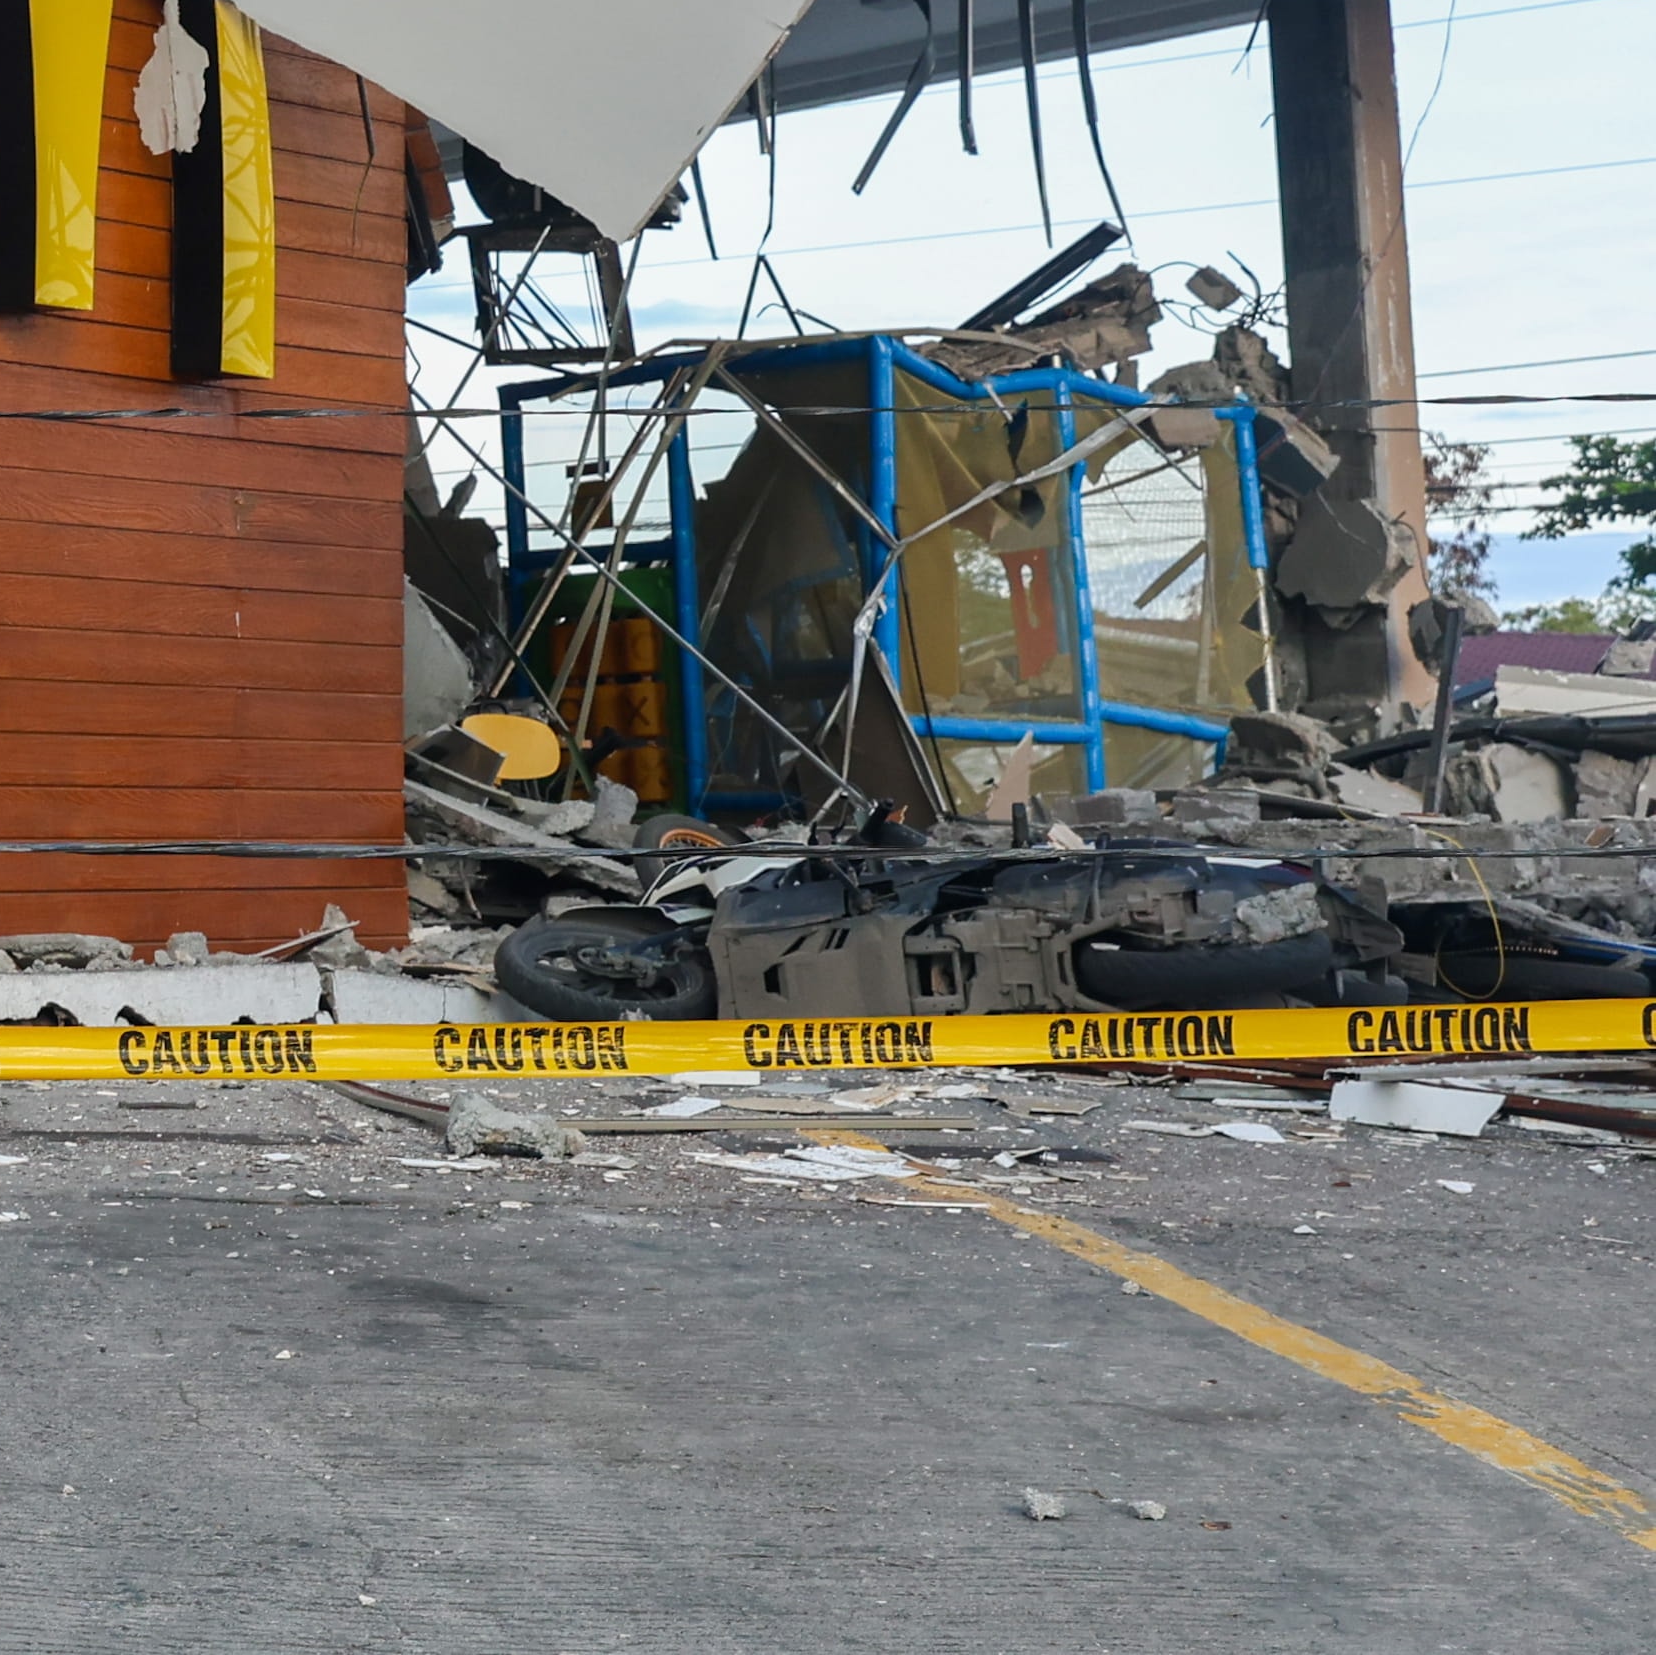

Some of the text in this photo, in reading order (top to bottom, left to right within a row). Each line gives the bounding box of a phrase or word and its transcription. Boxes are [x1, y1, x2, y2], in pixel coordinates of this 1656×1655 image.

[119, 1029, 316, 1075] CAUTION
[434, 1026, 630, 1072] CAUTION
[743, 1021, 935, 1068] CAUTION
[1048, 1015, 1235, 1061] CAUTION
[1347, 1007, 1532, 1054] CAUTION
